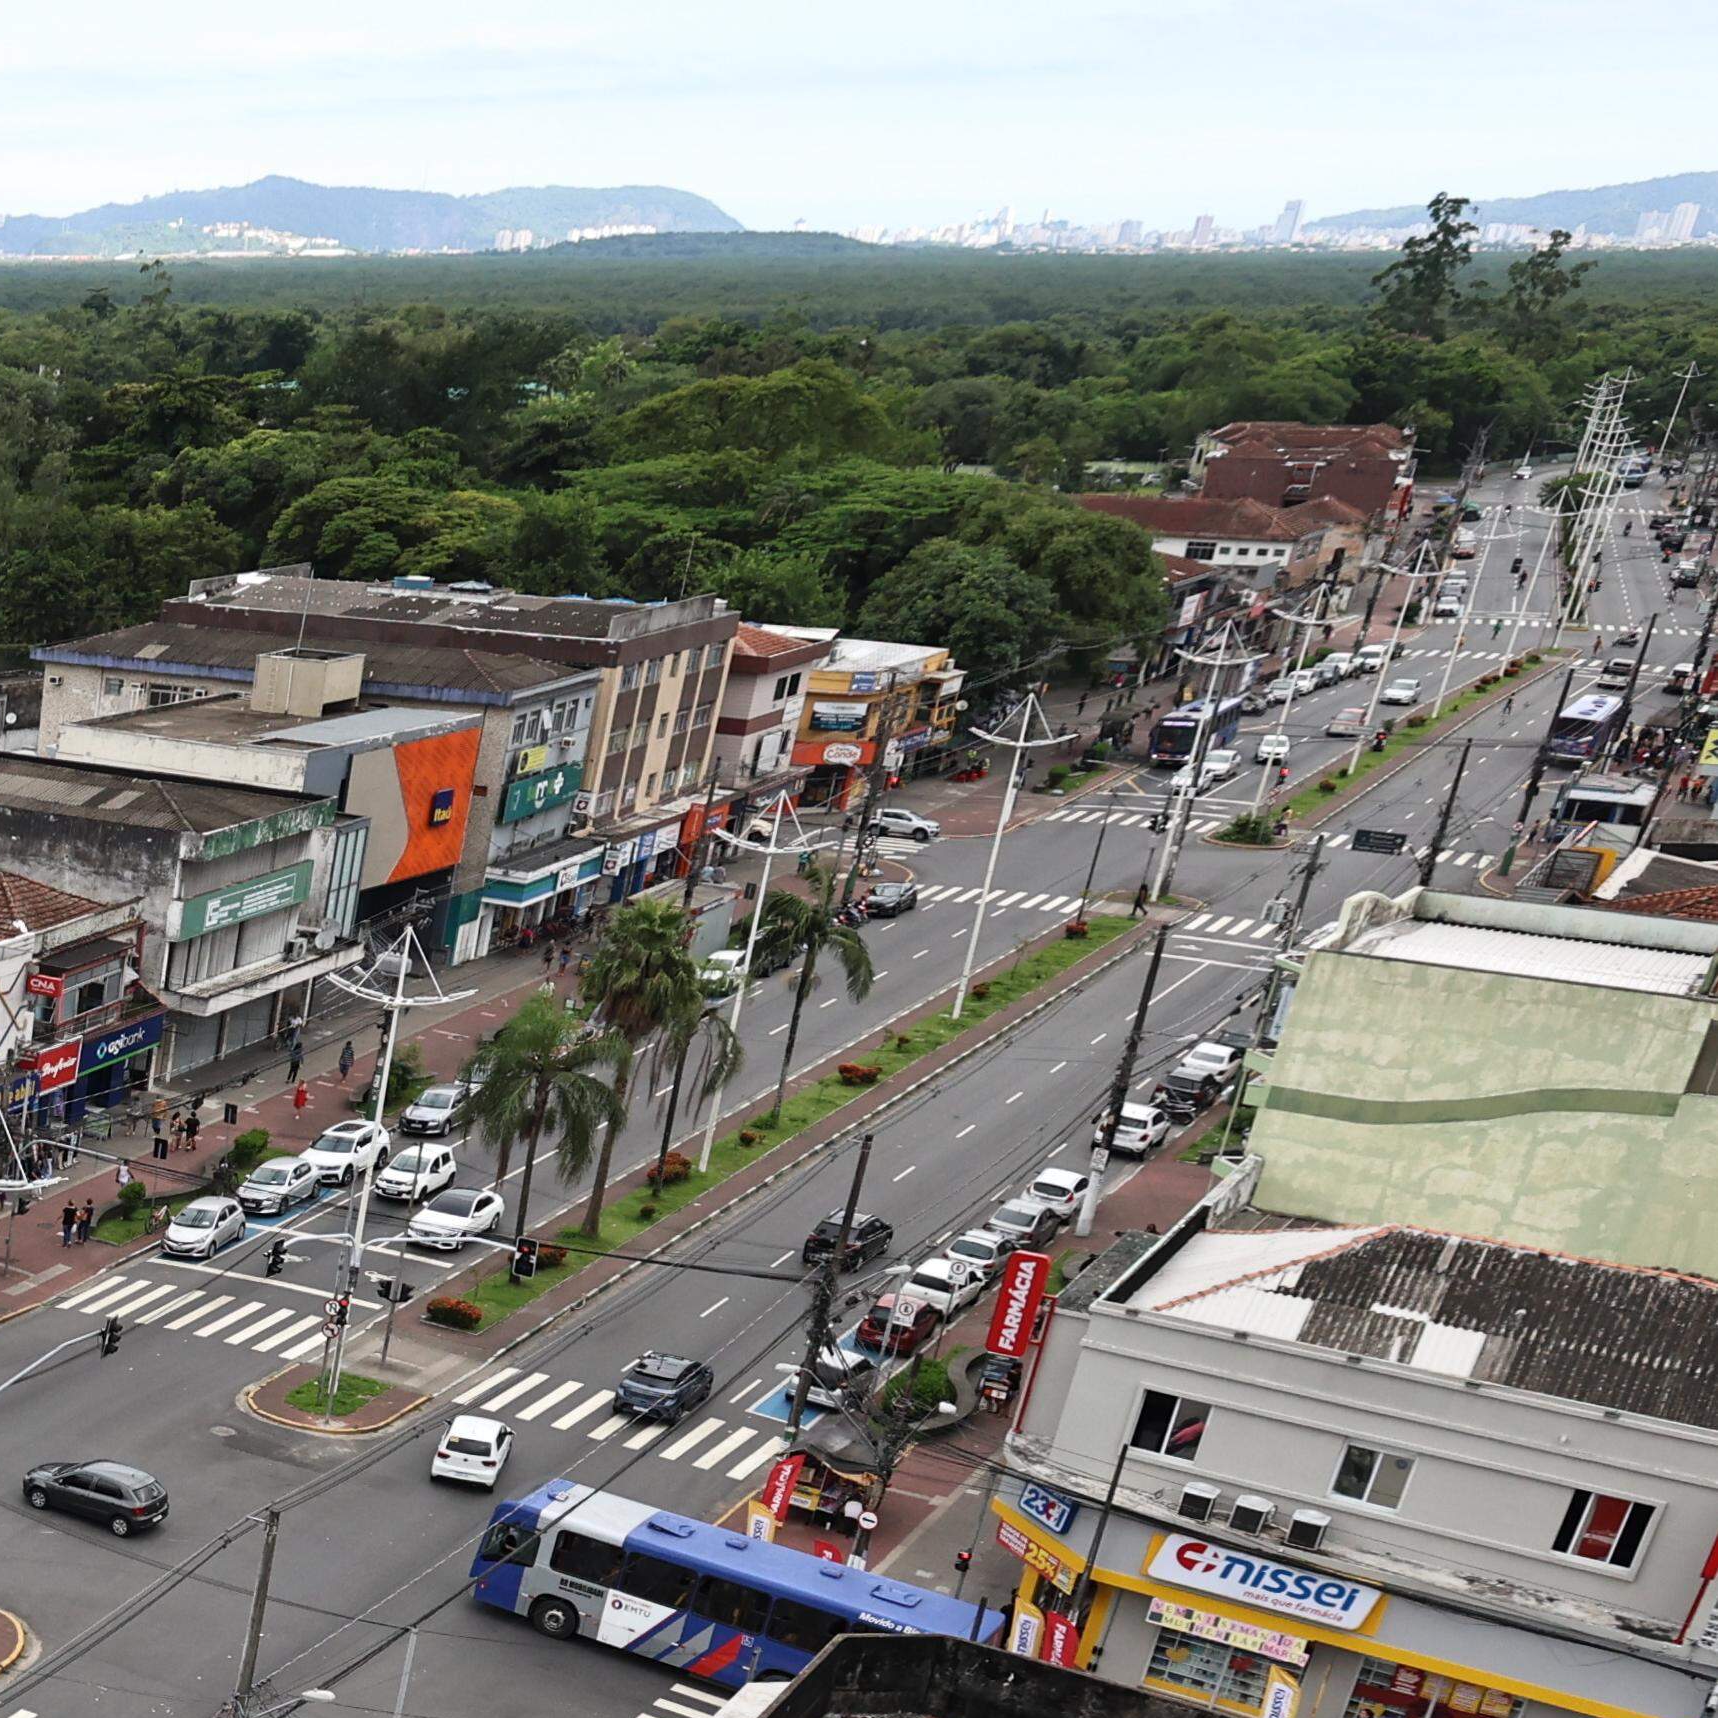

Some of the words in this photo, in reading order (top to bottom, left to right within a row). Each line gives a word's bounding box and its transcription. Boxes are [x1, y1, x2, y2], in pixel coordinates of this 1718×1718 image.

[30, 976, 56, 991] CNA
[106, 1027, 146, 1056] agibank
[997, 1261, 1037, 1352] FARMÁCIA
[770, 1464, 794, 1514] ARMÁCIA
[1024, 1543, 1057, 1580] 25%
[1219, 1555, 1362, 1612] nissei
[623, 1604, 651, 1618] EMTU
[858, 1612, 895, 1629] Movido
[1242, 1590, 1269, 1604] mais
[1271, 1596, 1293, 1610] que
[1294, 1601, 1344, 1623] farmácia
[1219, 1619, 1278, 1645] SEMANA
